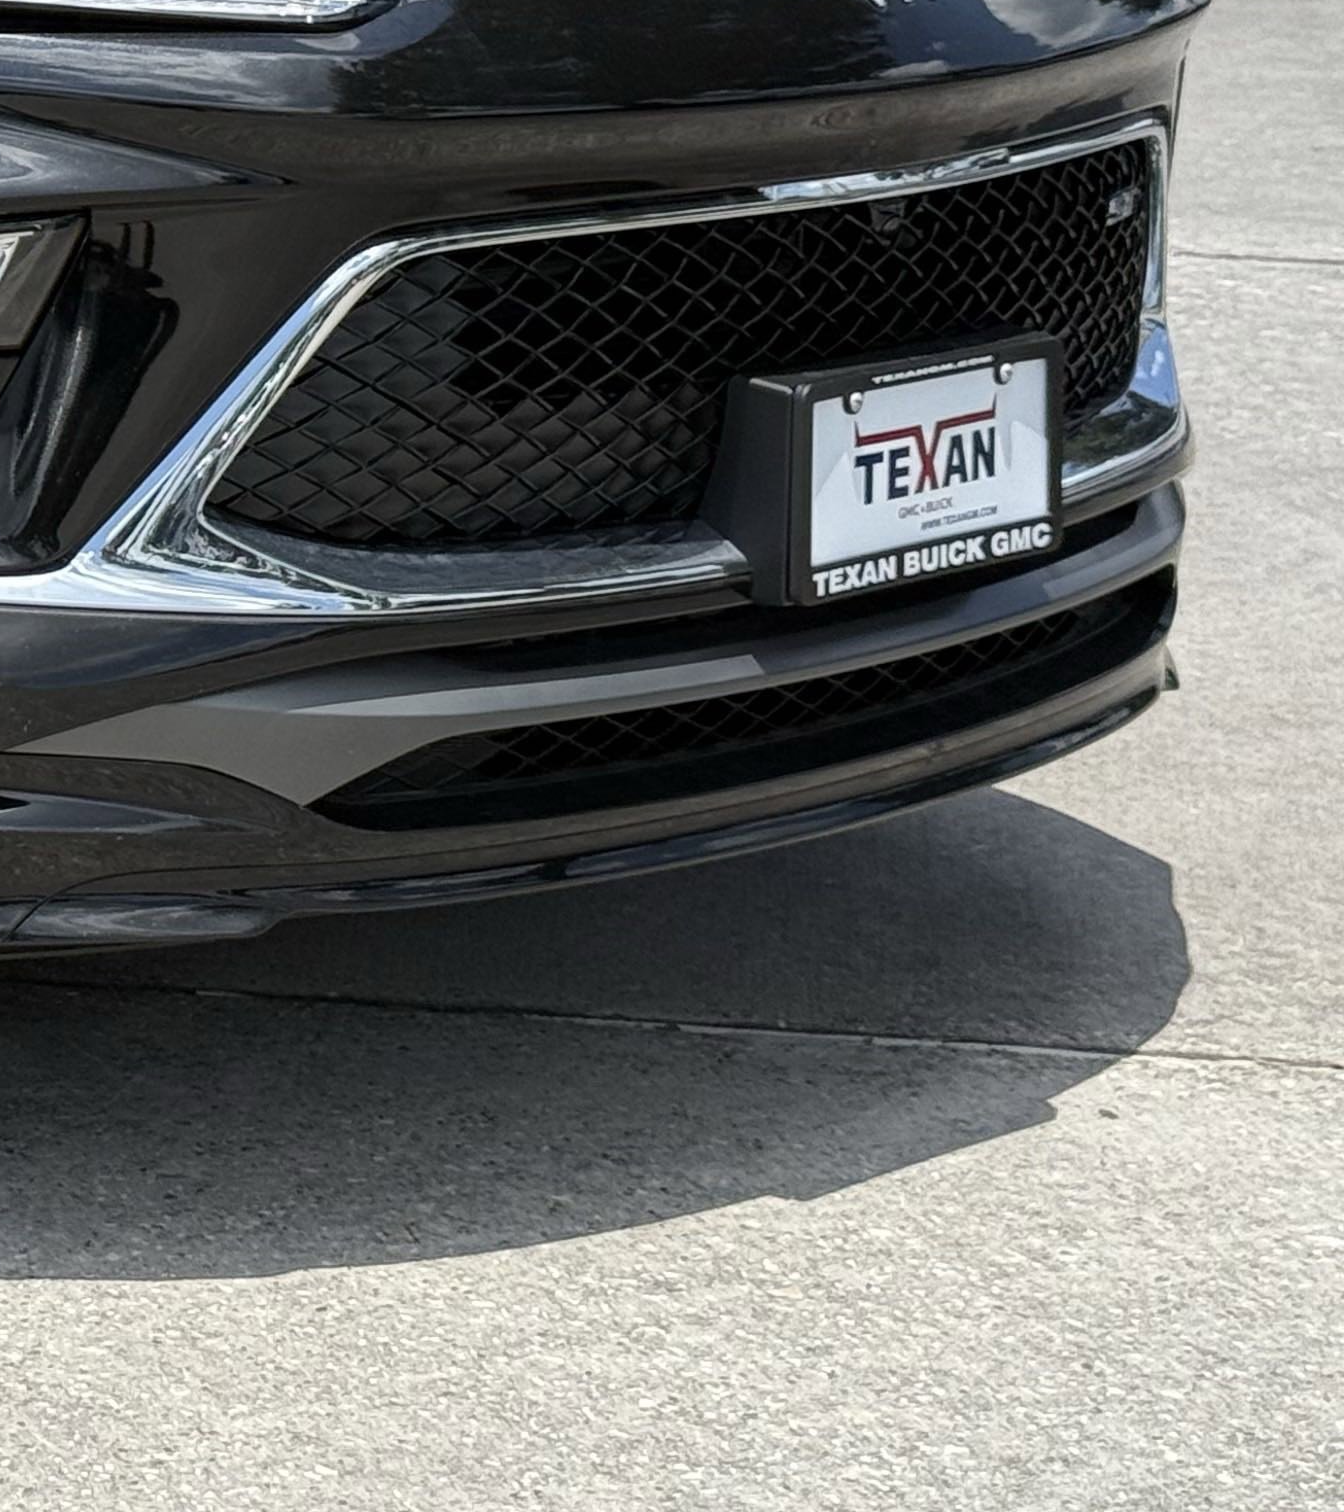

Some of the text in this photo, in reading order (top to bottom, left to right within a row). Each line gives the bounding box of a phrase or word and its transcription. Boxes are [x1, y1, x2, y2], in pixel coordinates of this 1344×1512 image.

[854, 425, 997, 506] TEXAN
[812, 522, 1054, 598] TEXAN BUICK GMC
